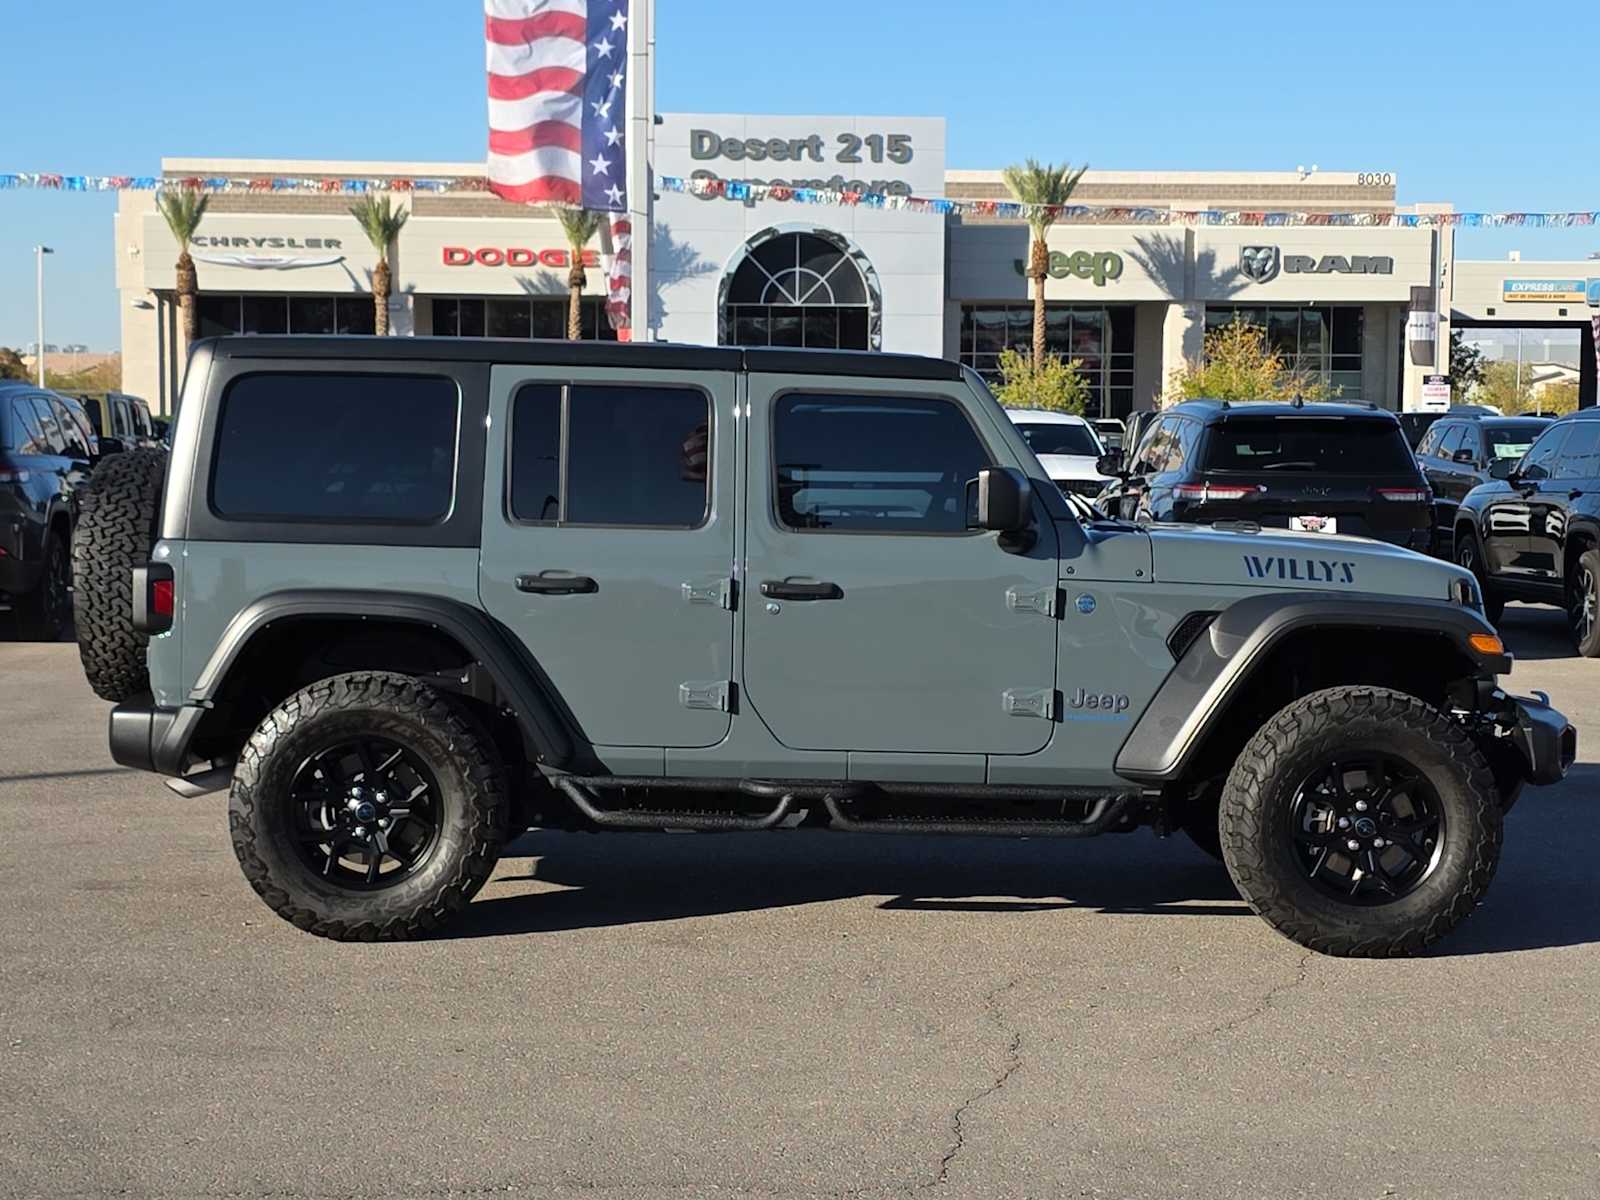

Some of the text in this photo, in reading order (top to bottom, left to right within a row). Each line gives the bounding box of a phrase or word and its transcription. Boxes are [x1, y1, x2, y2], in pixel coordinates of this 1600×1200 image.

[690, 129, 913, 164] Desert 215
[1358, 173, 1391, 186] 8030
[191, 236, 343, 249] CHRYSLER
[1284, 255, 1393, 274] RAM
[1243, 555, 1356, 583] WILLYS
[1071, 687, 1130, 714] Jeep
